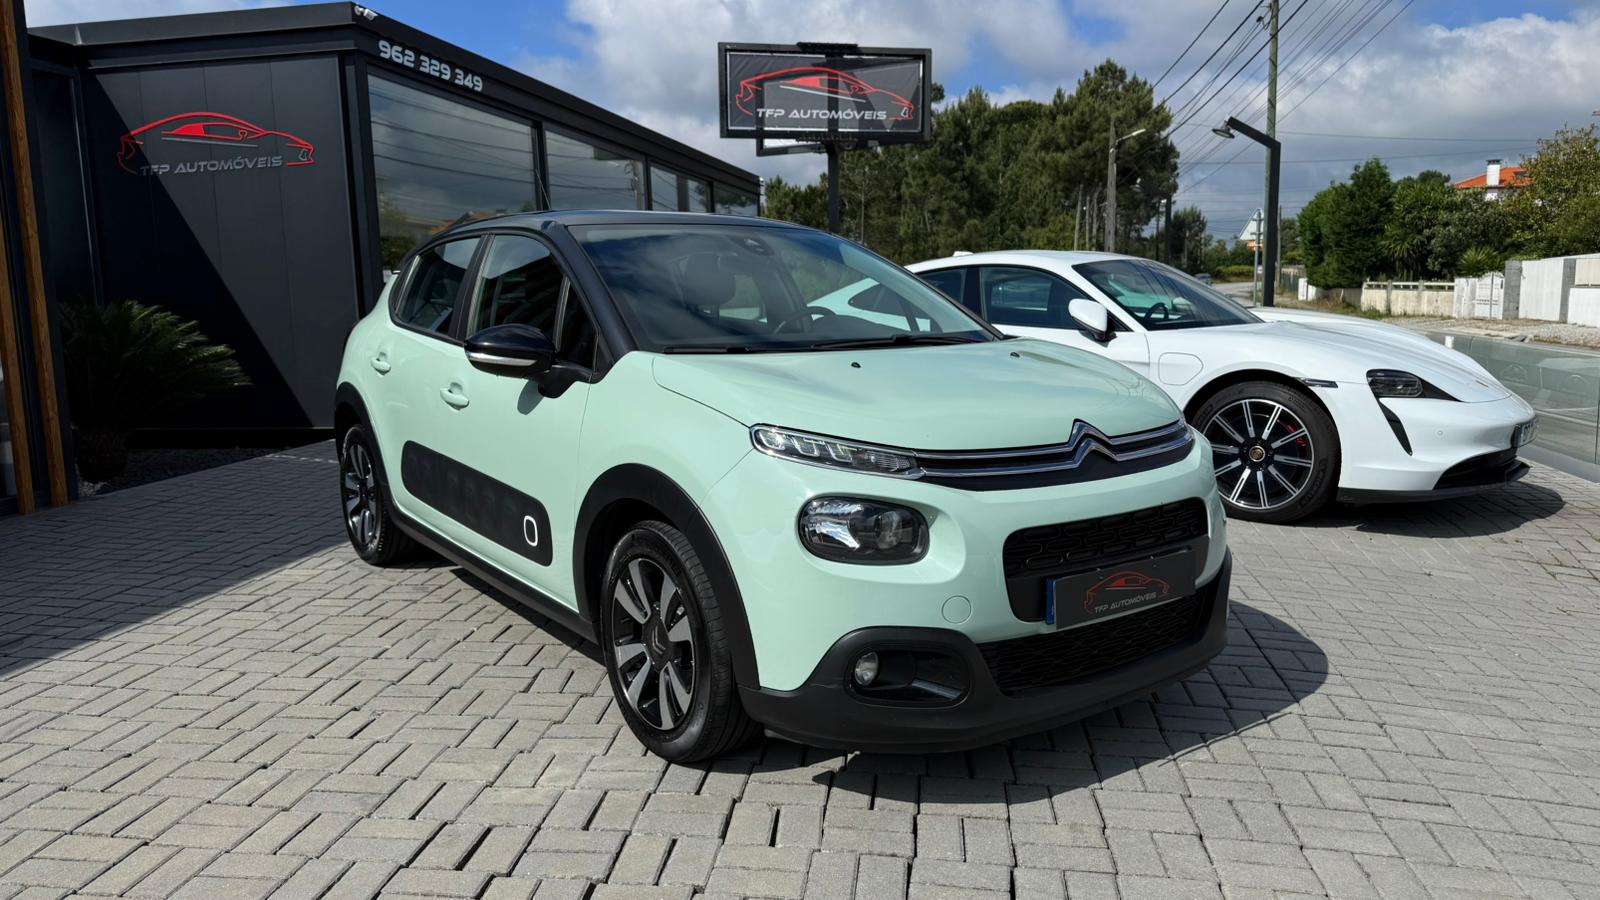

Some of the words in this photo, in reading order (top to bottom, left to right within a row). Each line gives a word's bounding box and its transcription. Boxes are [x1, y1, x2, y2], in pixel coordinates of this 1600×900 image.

[378, 40, 415, 68] 962
[419, 55, 451, 80] 329
[454, 68, 483, 92] 349
[757, 108, 785, 118] TFP
[788, 108, 887, 120] AUTOMÓVEIS
[140, 165, 170, 176] TFP
[174, 155, 283, 174] AUTOMÓVEIS
[1094, 605, 1109, 614] TFP
[1110, 591, 1157, 610] AUTOMÓVEIS
